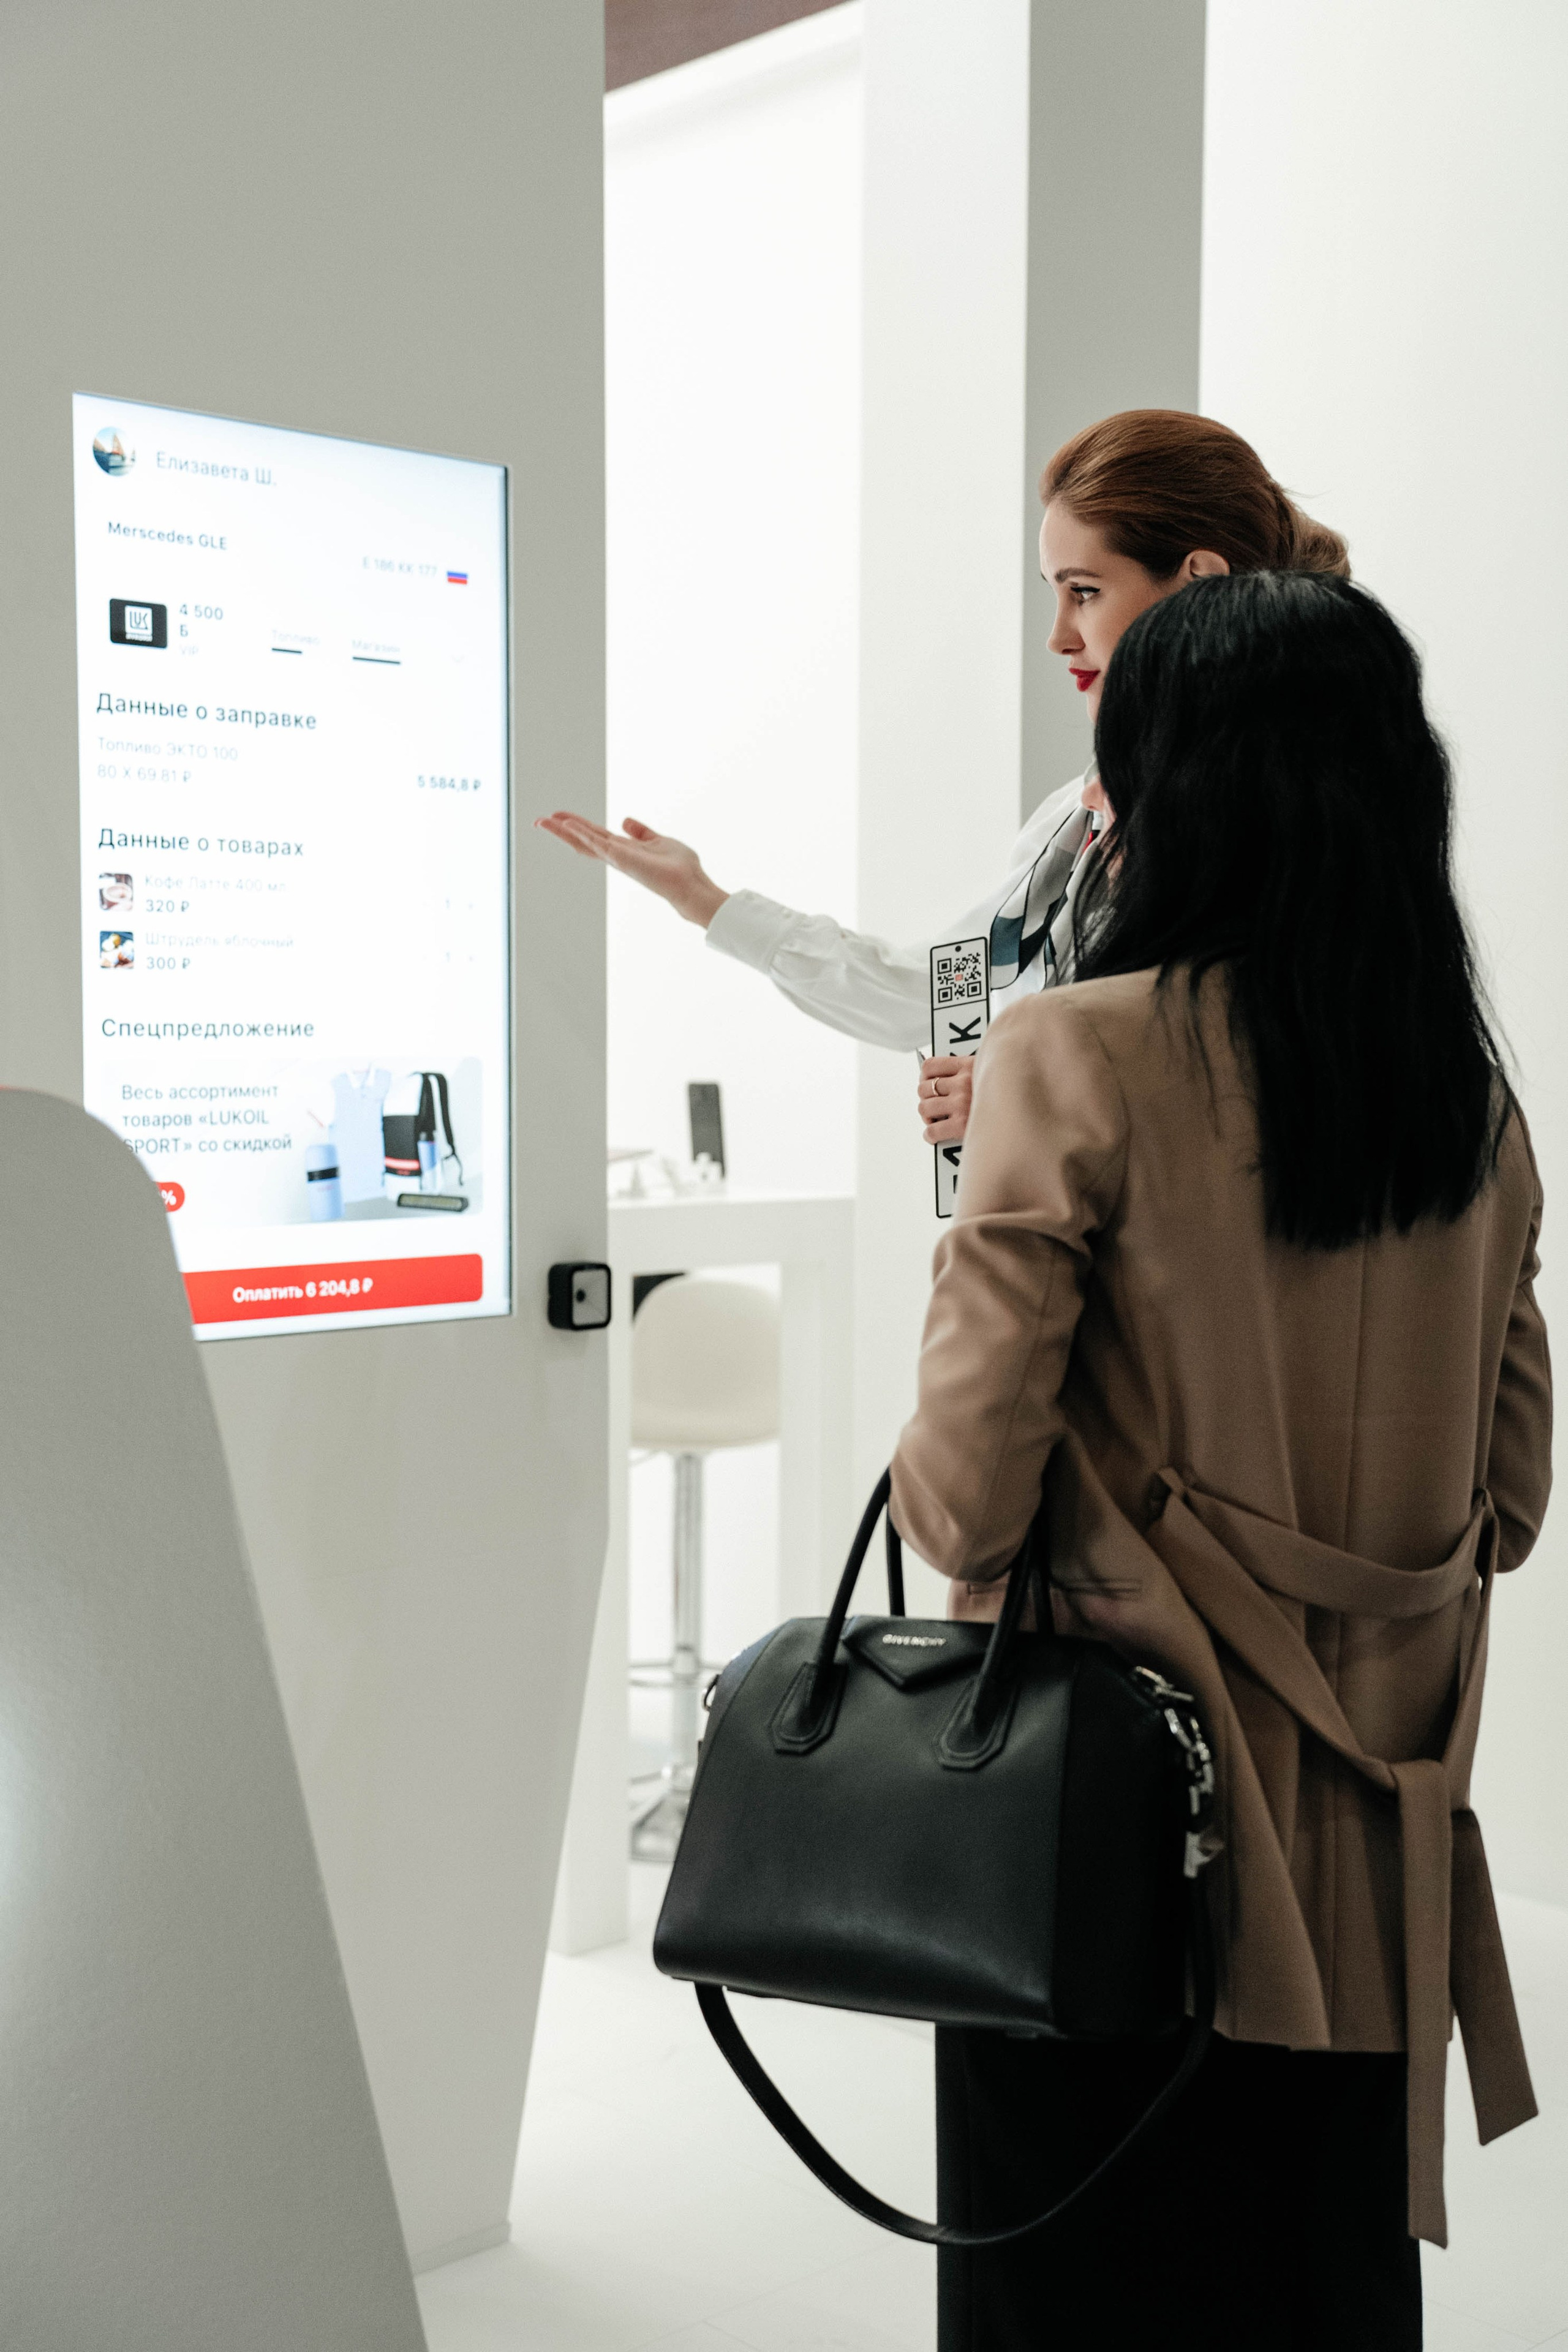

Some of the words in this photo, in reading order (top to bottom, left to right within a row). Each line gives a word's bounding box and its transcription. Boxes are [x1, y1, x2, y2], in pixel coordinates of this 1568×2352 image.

[156, 451, 249, 481] Елизавета
[255, 467, 277, 486] Ш.
[108, 521, 194, 546] Merscedes
[198, 533, 228, 550] GLE
[179, 603, 189, 616] 4
[194, 604, 224, 621] 500
[96, 692, 189, 719] Данные
[195, 705, 208, 720] о
[215, 706, 317, 730] заправке
[98, 736, 161, 756] Топливо
[213, 746, 239, 761] 100
[97, 764, 117, 779] 80
[418, 774, 426, 788] 5
[429, 775, 469, 793] 584,8
[98, 827, 190, 851] Данные
[197, 837, 209, 852] о
[217, 837, 304, 859] товарах
[144, 874, 184, 891] Кофе
[145, 898, 176, 914] 320
[146, 956, 177, 971] 300
[102, 1018, 315, 1041] Спецпредложение
[121, 1084, 164, 1101] Весь
[169, 1085, 279, 1102] ассортимент
[123, 1113, 193, 1129] товаров
[198, 1139, 219, 1153] со
[223, 1133, 292, 1153] скидкой
[232, 1286, 304, 1304] Оплатить
[305, 1280, 317, 1298] 6
[318, 1277, 361, 1298] 204,8
